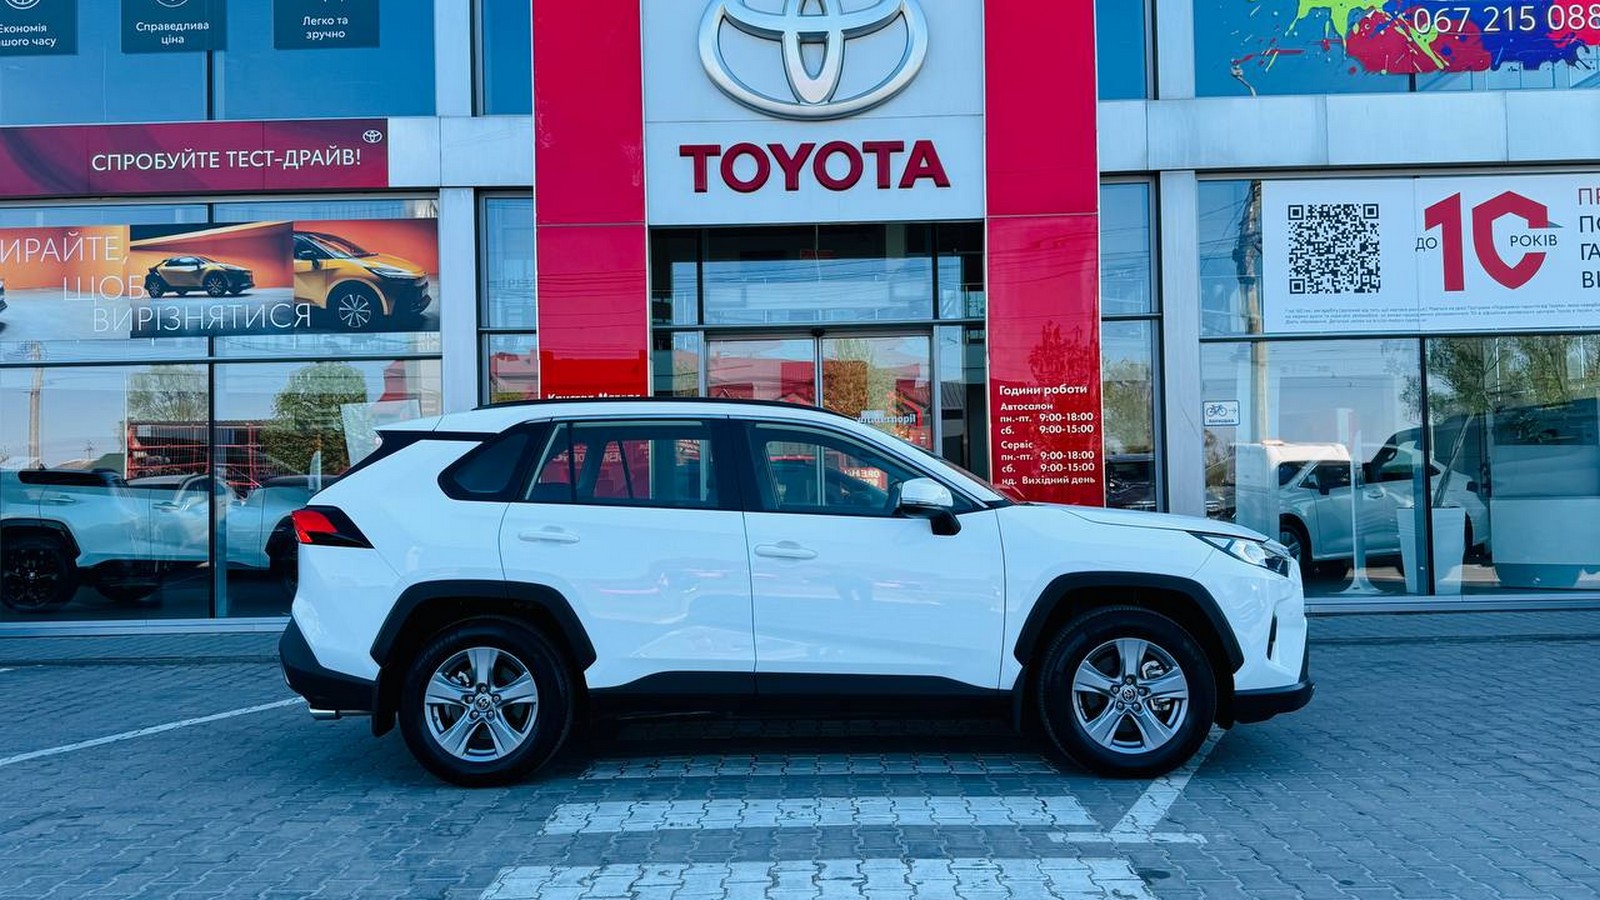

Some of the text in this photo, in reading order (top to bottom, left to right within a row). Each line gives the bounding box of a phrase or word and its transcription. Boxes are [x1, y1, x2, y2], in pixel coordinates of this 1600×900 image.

[303, 16, 349, 26] Легко та
[1414, 4, 1600, 34] 067 215 088
[136, 21, 210, 33] Справедлива
[161, 34, 185, 45] ціна
[305, 30, 346, 41] зручно
[32, 38, 57, 48] часу
[91, 145, 361, 171] СПРОБУЙТЕ ТЕСТ-ДРАЙВ!
[679, 140, 950, 193] TOYOTA
[0, 231, 129, 264] ИРАЙТЕ,
[1415, 237, 1437, 252] ДО
[1510, 234, 1558, 247] РОКІВ
[63, 275, 146, 305] ЩОБ
[94, 302, 312, 332] ВИРІЗНЯТИСЯ
[999, 384, 1087, 396] Години роботи
[1000, 403, 1053, 411] Автосалон
[1039, 413, 1094, 422] 9:00-18:00
[1000, 425, 1094, 435] сб. 9:00-15:00
[1001, 440, 1033, 451] Сервіс
[1001, 451, 1095, 461] пн.-пт. 9:00-18:00
[1001, 463, 1095, 473] сб. 9:00-15:00
[1002, 475, 1096, 486] нд. Вихідний день
